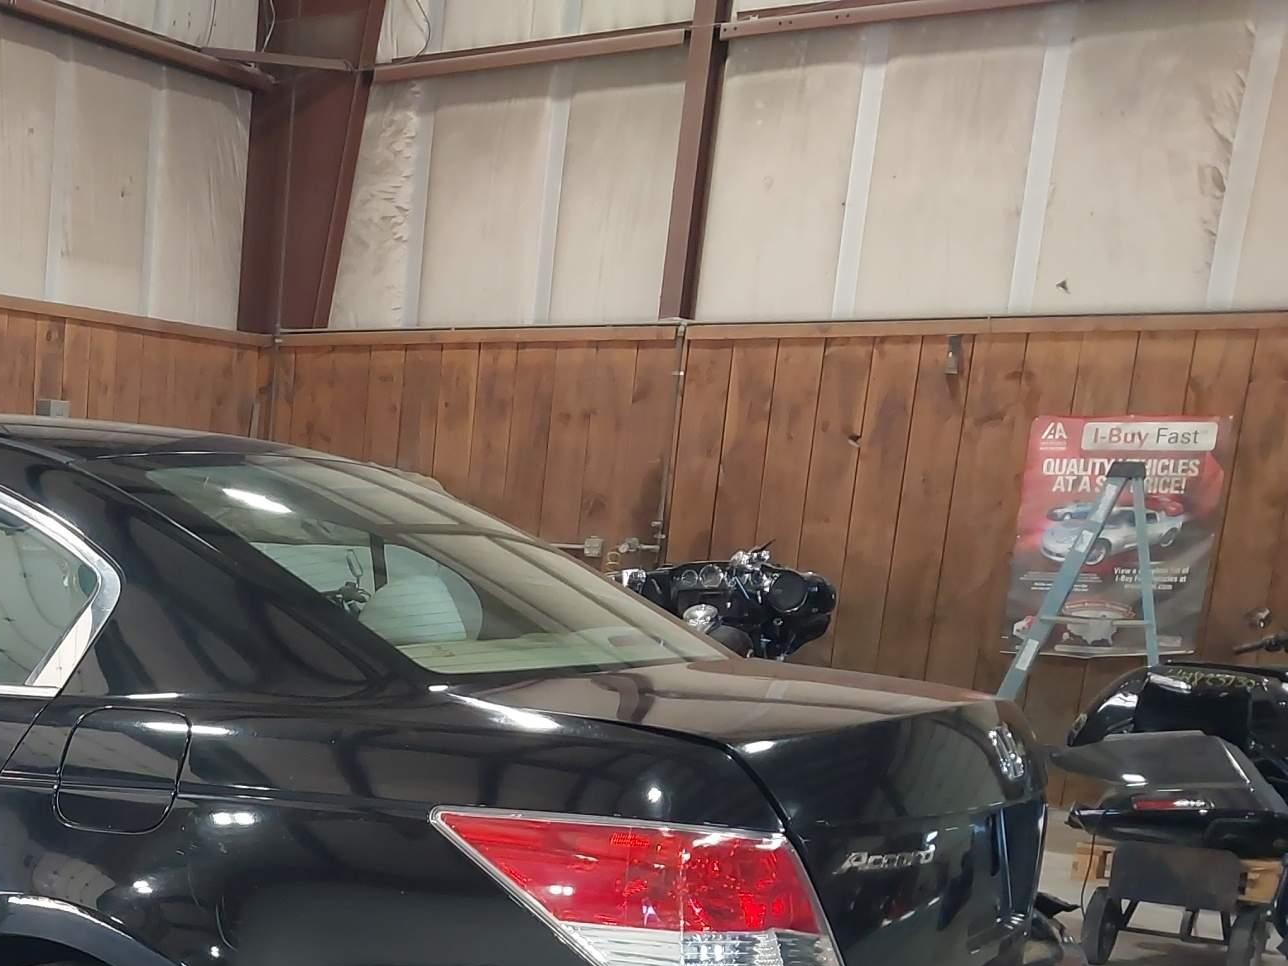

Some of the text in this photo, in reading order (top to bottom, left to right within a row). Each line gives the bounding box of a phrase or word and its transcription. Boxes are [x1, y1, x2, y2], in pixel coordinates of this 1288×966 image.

[1093, 427, 1201, 447] I-Buy Fast
[1043, 458, 1114, 476] QUALITY
[1052, 476, 1077, 492] AT
[1078, 476, 1091, 492] A
